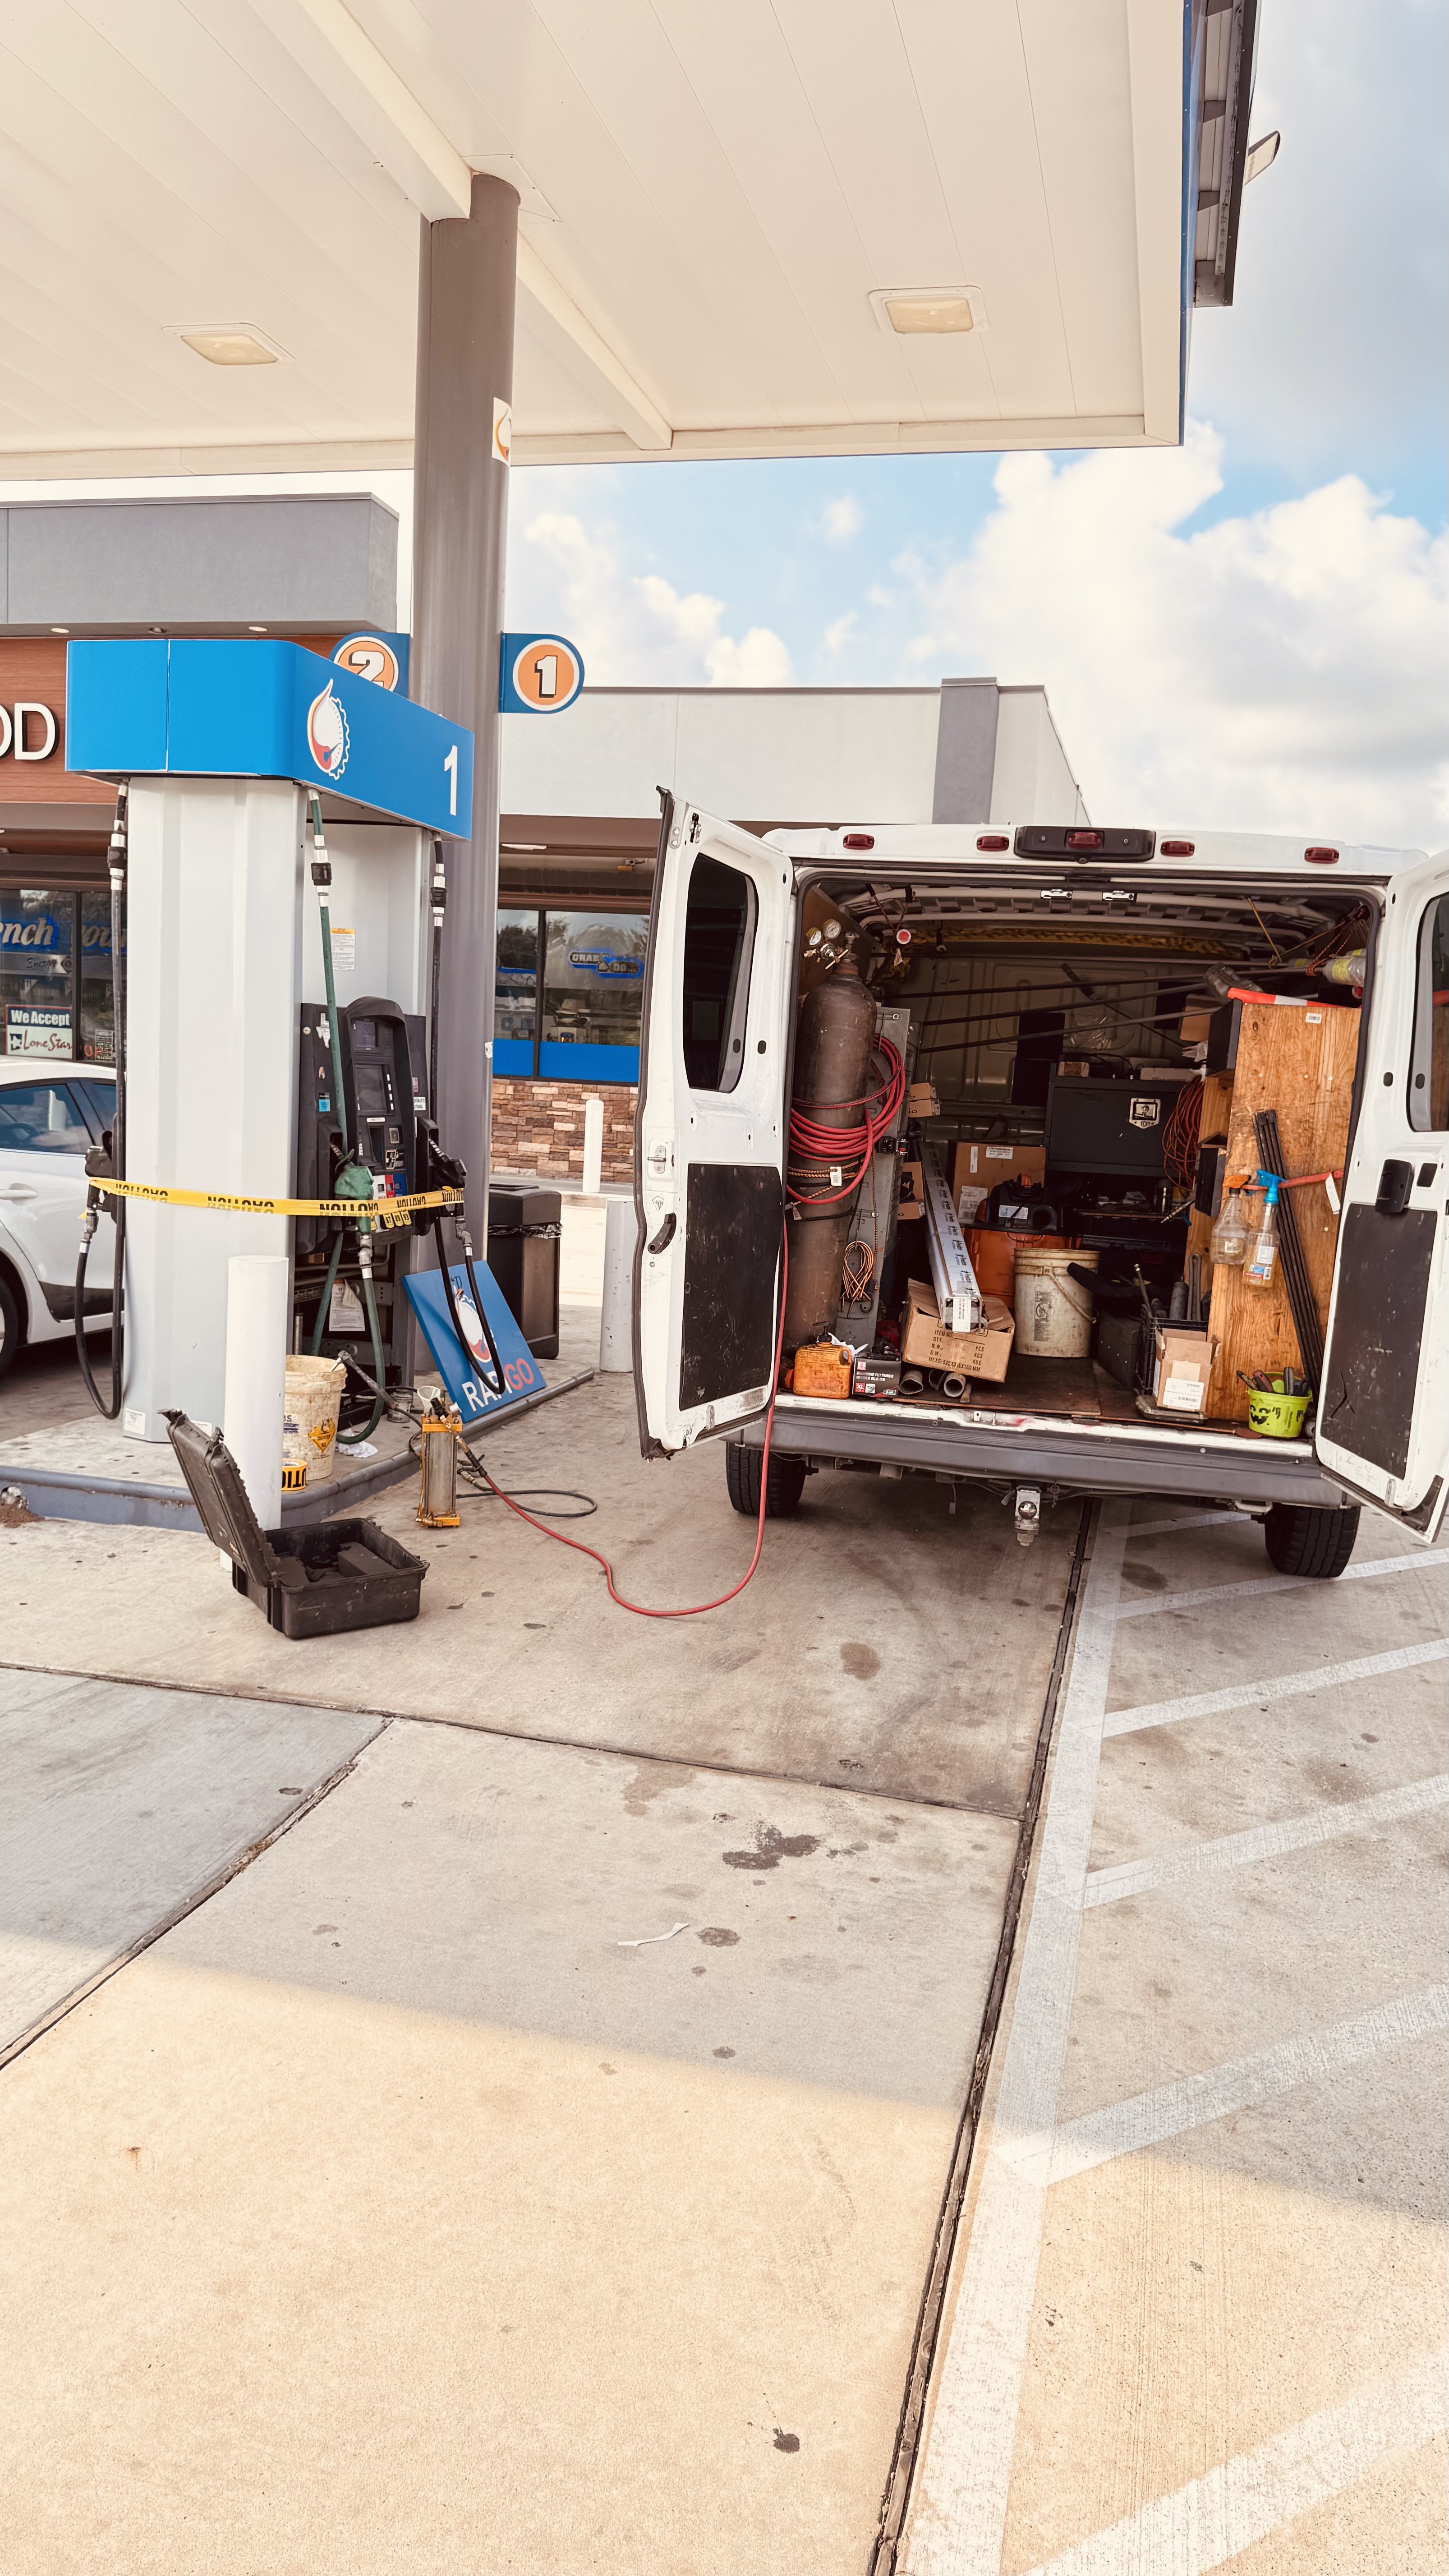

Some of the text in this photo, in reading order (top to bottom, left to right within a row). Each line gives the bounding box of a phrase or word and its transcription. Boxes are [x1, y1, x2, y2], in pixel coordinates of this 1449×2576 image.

[350, 650, 385, 685] 2
[535, 655, 557, 698] 1
[0, 703, 56, 760] D
[444, 745, 458, 816] 1
[0, 917, 54, 946] nch
[26, 956, 58, 969] Energy
[572, 953, 600, 962] GRAB
[11, 1010, 70, 1026] We Accept
